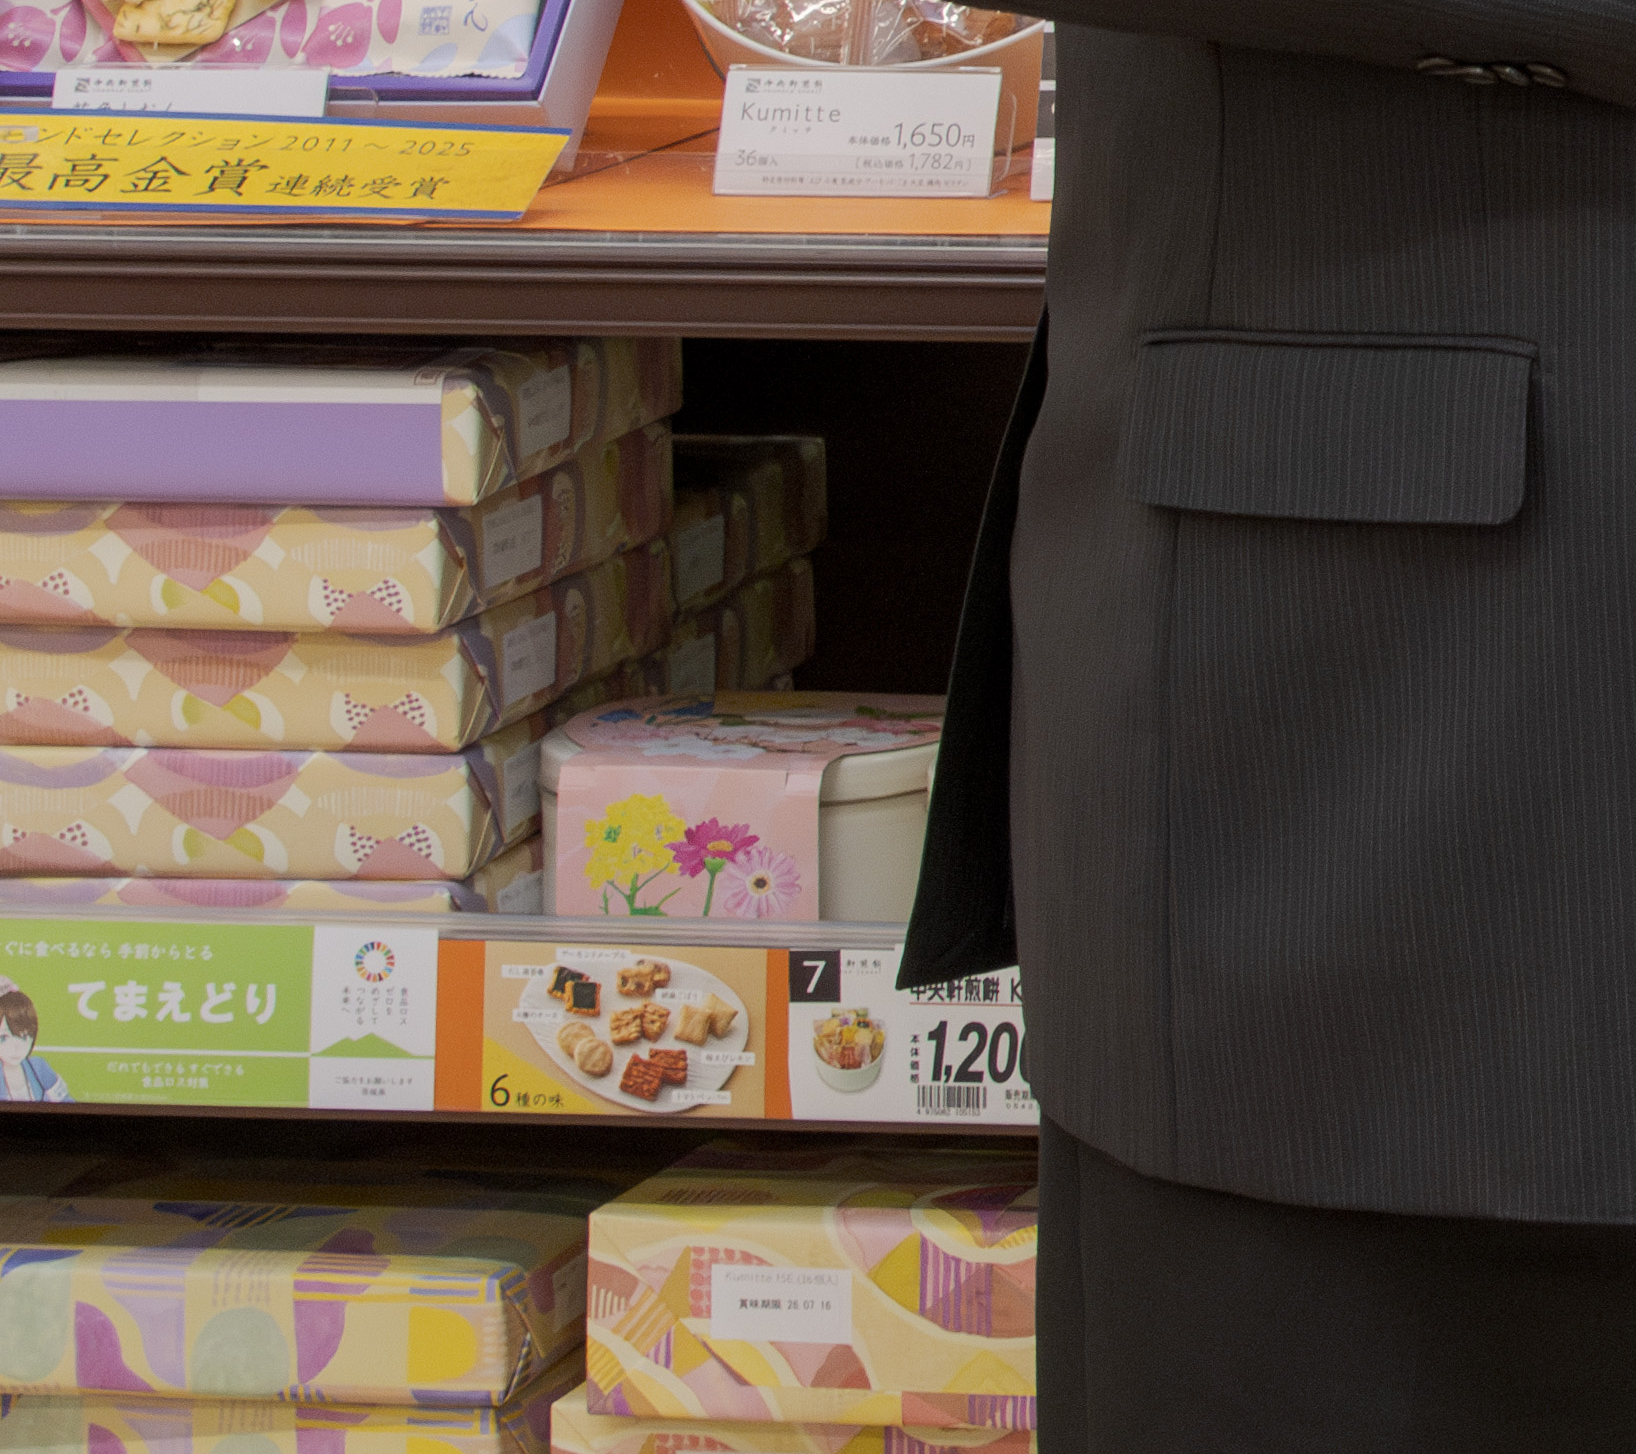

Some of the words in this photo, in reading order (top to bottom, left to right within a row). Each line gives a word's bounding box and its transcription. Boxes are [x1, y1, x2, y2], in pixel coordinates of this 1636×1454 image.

[741, 101, 841, 124] Kumitte
[67, 981, 277, 1025] てまえどり
[927, 1020, 1030, 1084] 1,20
